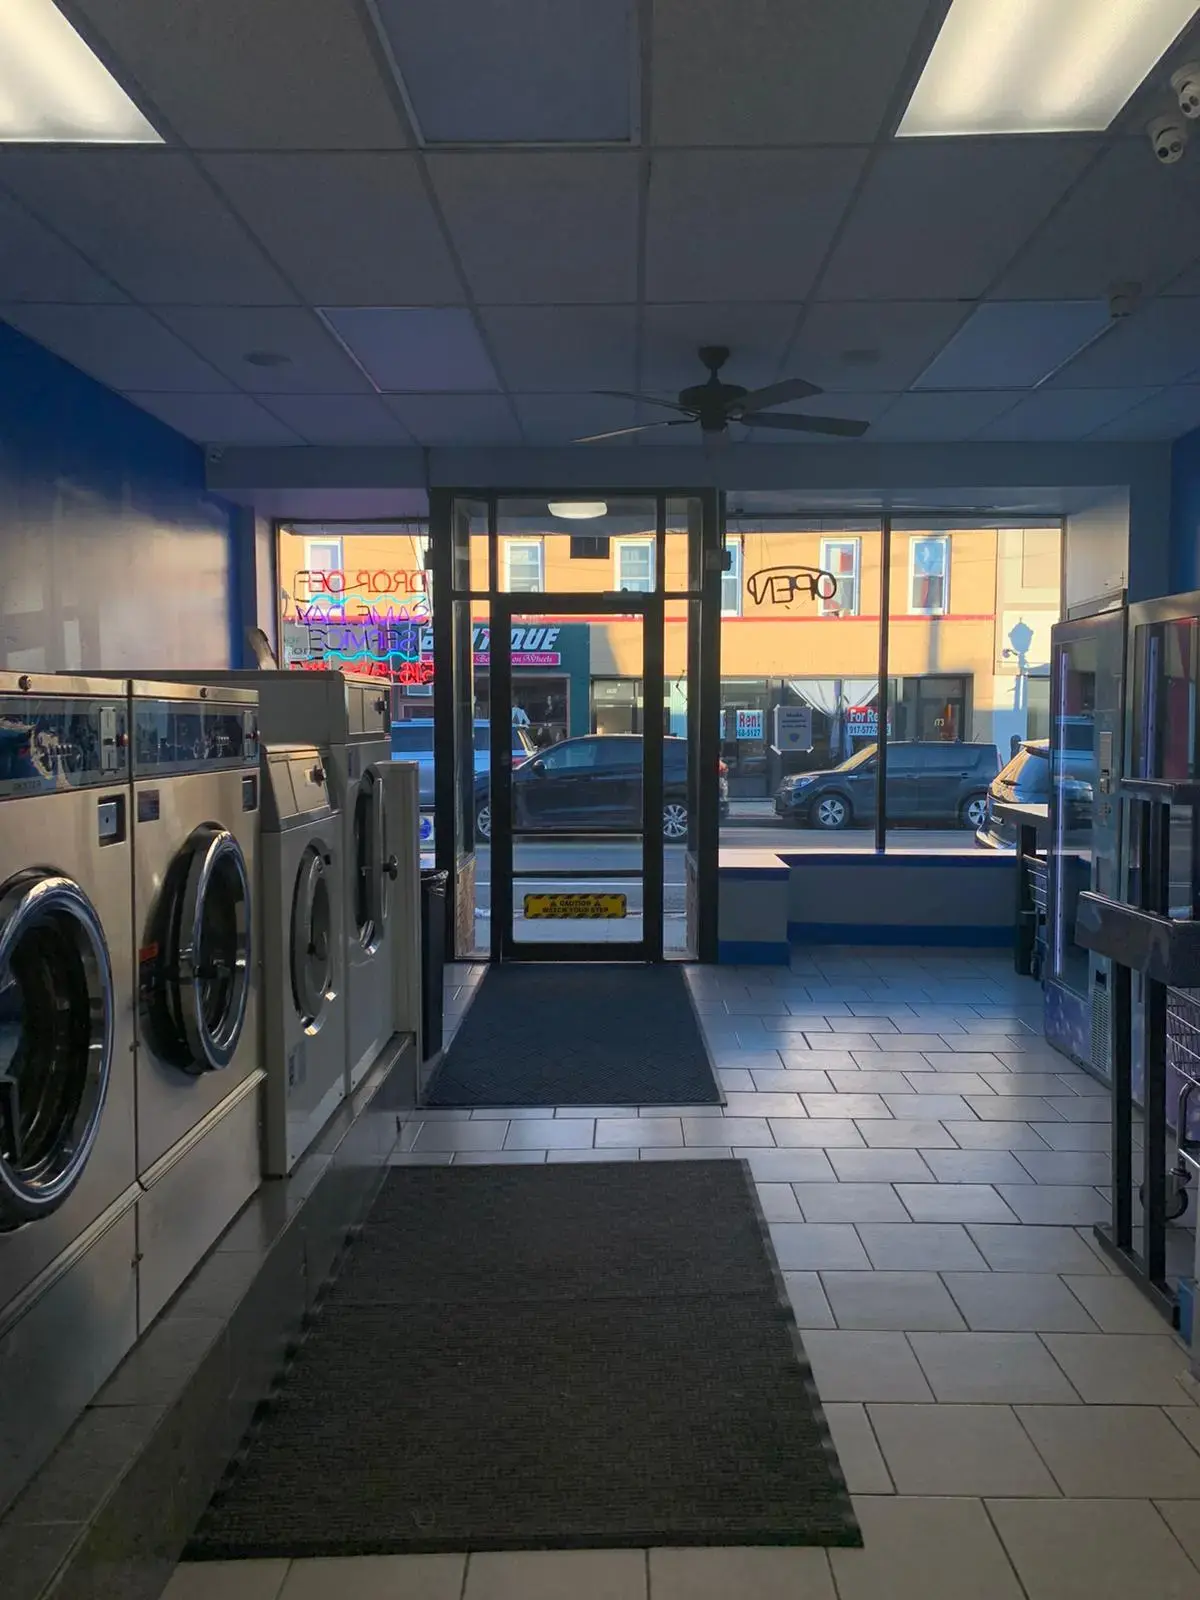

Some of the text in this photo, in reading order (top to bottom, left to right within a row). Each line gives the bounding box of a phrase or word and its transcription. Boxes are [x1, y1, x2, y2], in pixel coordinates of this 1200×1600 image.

[739, 711, 761, 728] Rent
[850, 708, 866, 722] For
[559, 899, 592, 907] CAUTION
